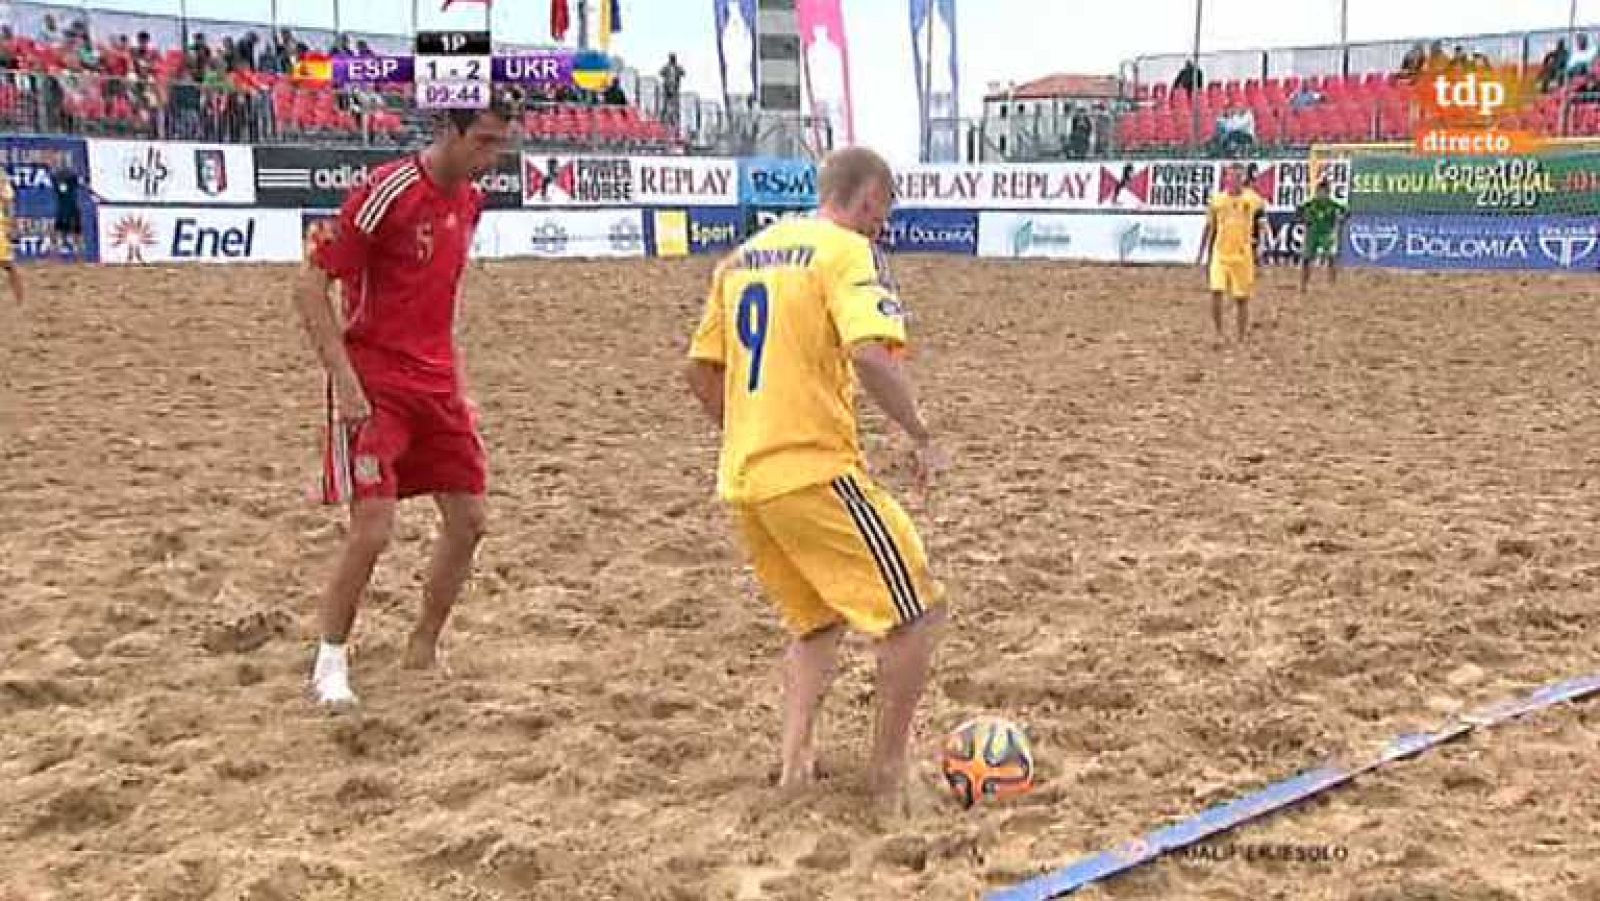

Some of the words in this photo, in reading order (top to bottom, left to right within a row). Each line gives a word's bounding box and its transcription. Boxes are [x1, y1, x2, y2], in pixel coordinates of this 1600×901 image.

[640, 166, 732, 195] REPLAY
[991, 171, 1092, 200] REPLAY
[1152, 163, 1215, 184] POWER
[1352, 172, 1382, 191] SEE
[1386, 172, 1422, 192] YOU
[1151, 185, 1212, 206] HORSE
[170, 217, 256, 257] Enel
[736, 281, 769, 393] 9
